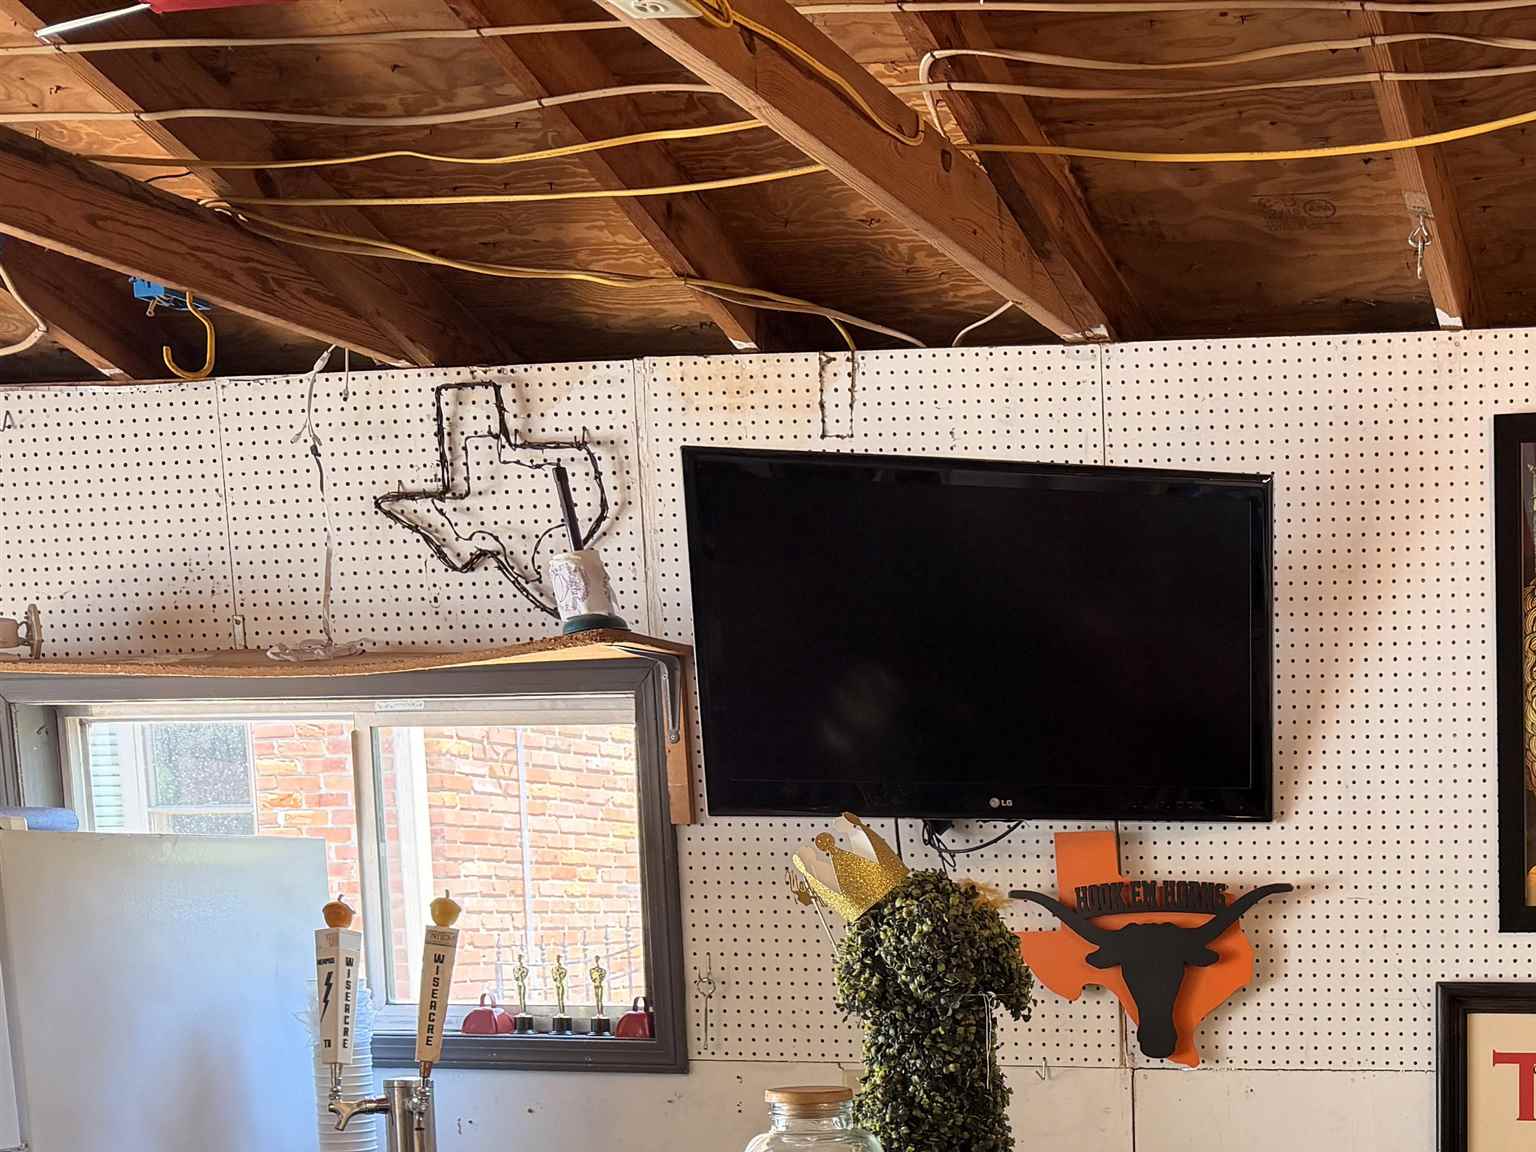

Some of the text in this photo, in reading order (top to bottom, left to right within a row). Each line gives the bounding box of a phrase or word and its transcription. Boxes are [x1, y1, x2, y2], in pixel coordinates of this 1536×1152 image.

[1001, 799, 1013, 807] LG
[1074, 881, 1126, 911] HOOK
[1163, 880, 1229, 912] HORNS
[342, 957, 354, 1049] WISEACRE
[425, 953, 446, 1047] WISEACRE
